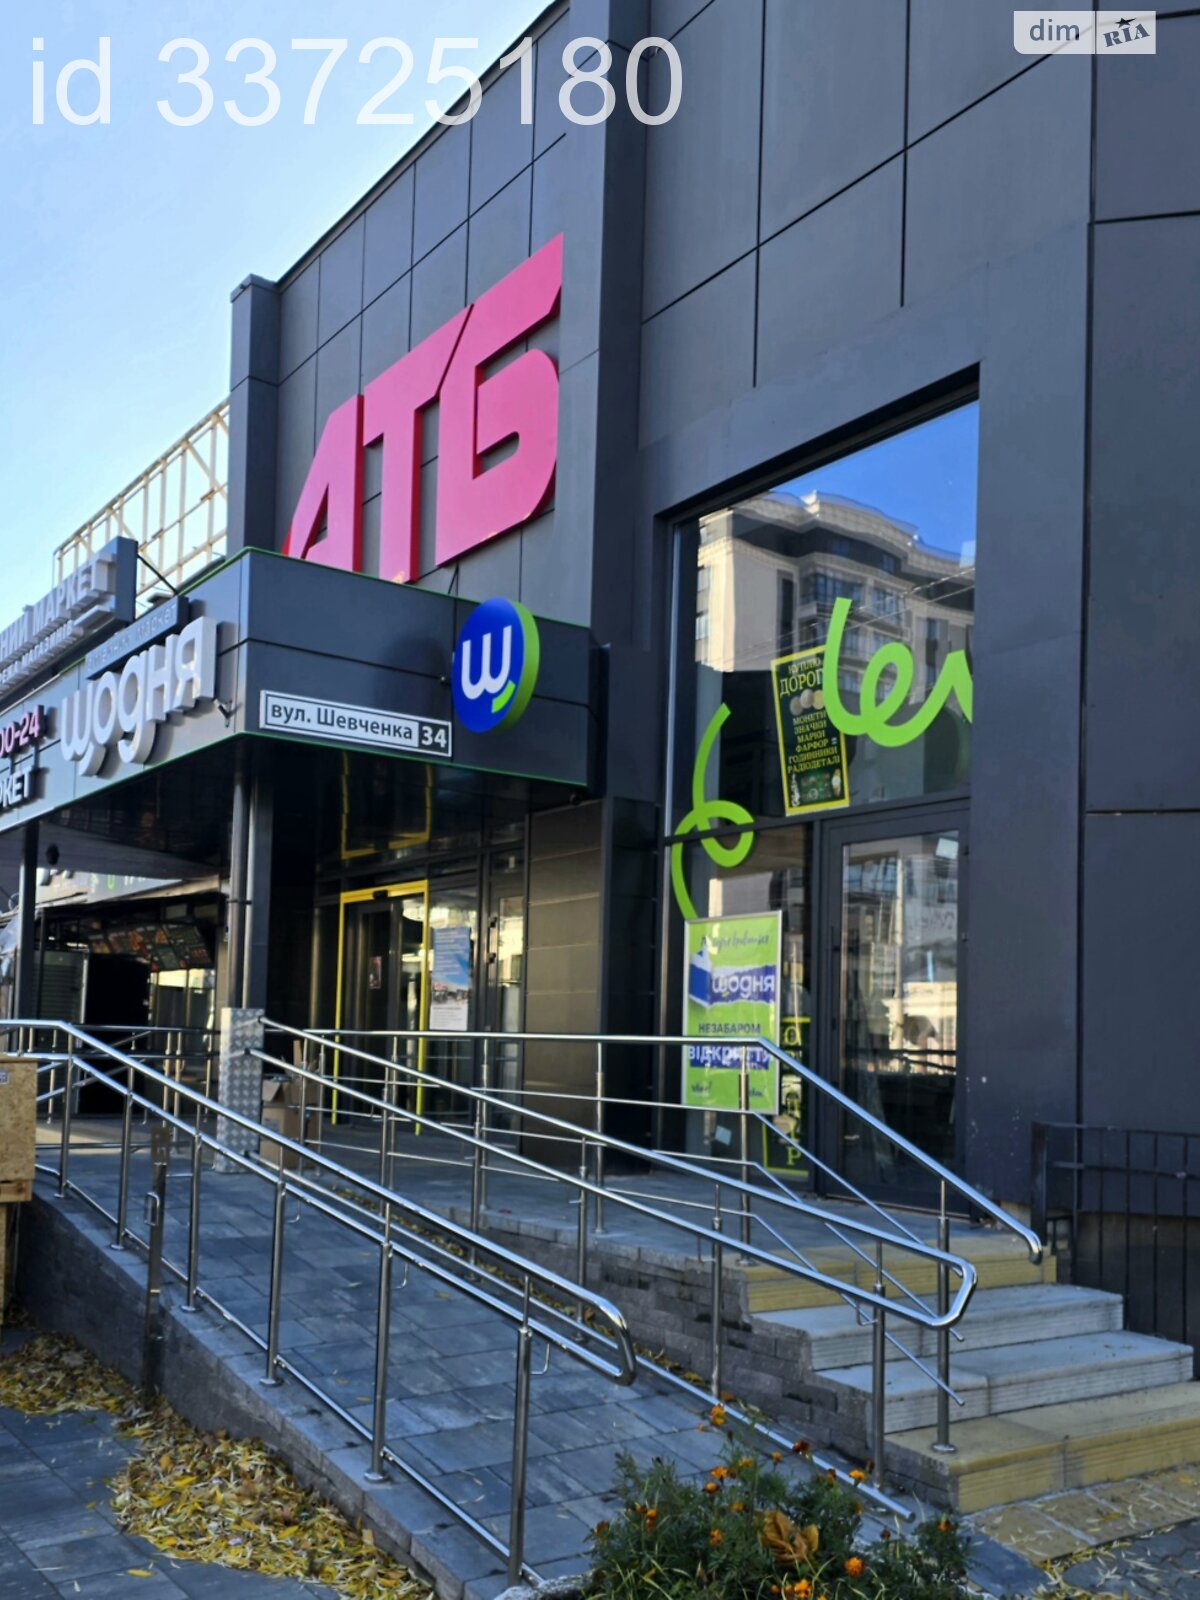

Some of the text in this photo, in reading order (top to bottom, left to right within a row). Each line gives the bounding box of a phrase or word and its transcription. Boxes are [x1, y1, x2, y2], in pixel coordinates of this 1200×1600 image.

[282, 231, 564, 583] АТБ
[780, 669, 823, 697] ДОРОГ
[271, 703, 448, 749] вул. Шевченка 34
[795, 738, 829, 753] ФАРФОР
[698, 1022, 762, 1034] НЕЗАБАРОМ
